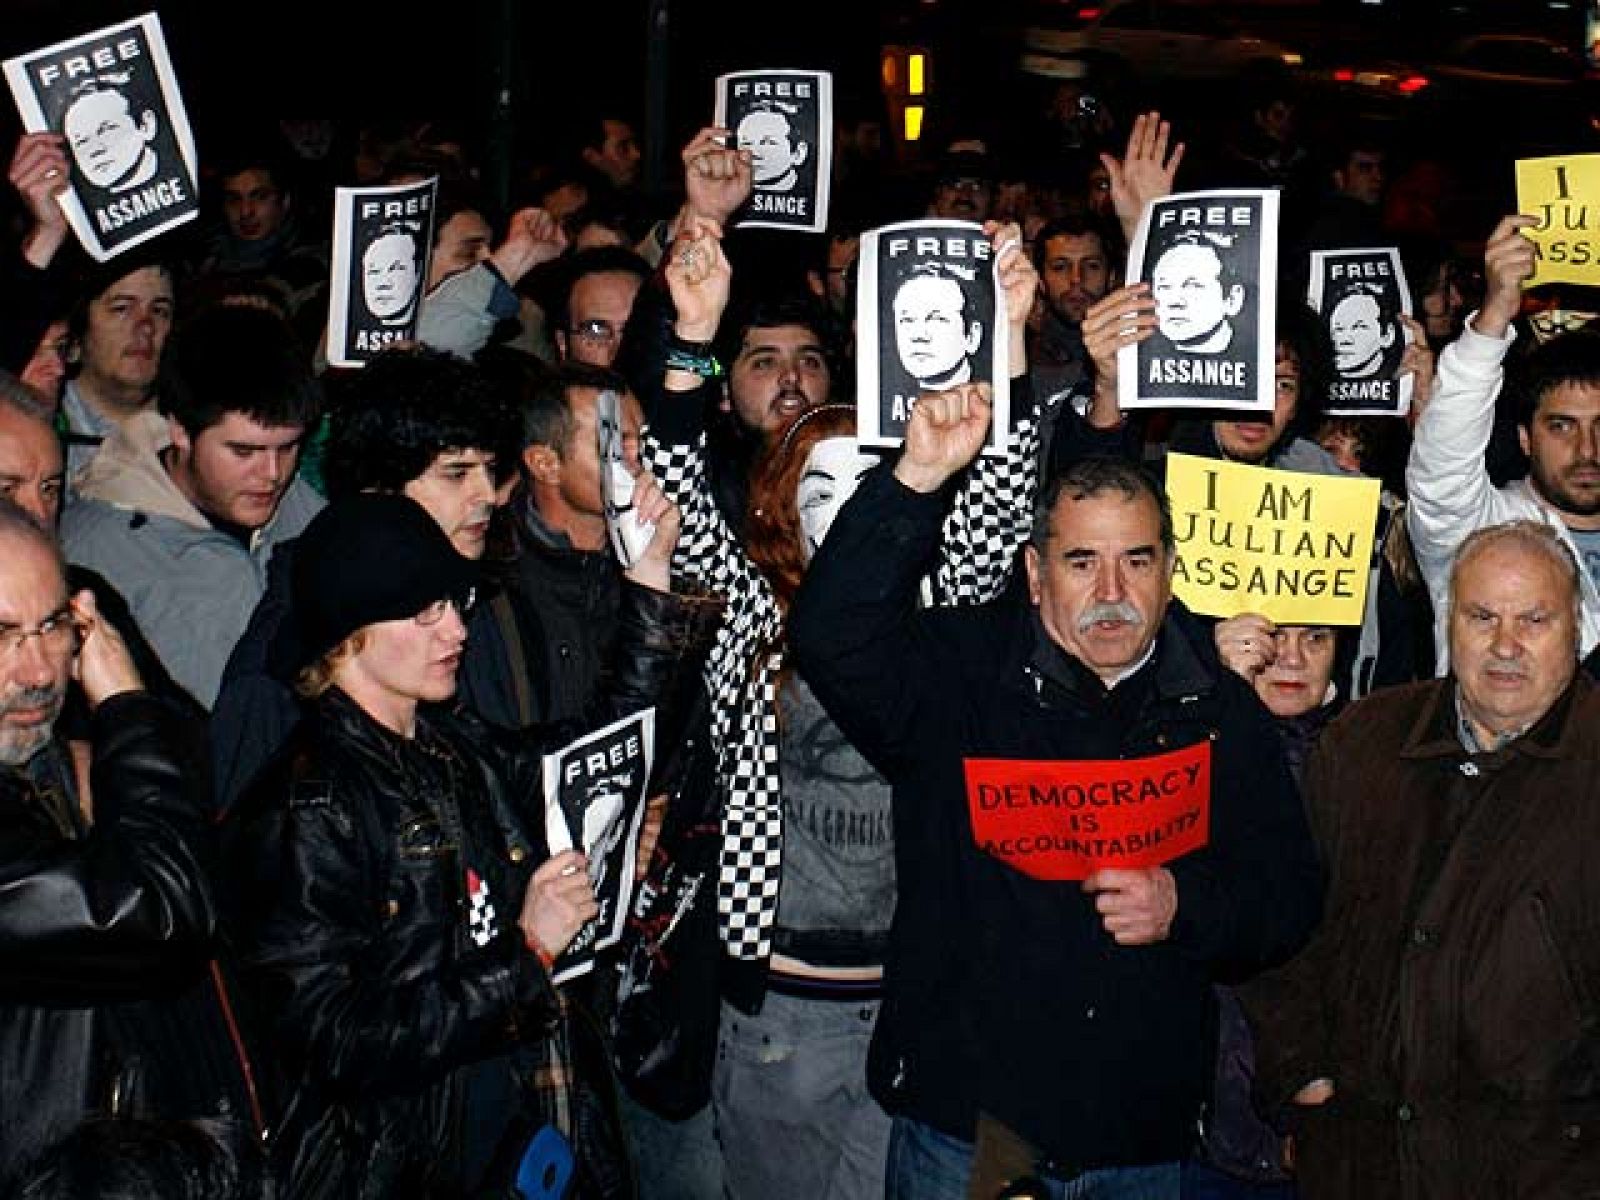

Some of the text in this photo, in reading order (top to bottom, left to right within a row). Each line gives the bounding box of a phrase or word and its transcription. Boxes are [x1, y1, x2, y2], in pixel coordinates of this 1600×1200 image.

[38, 39, 142, 86] FREE
[734, 81, 812, 99] FREE
[1554, 164, 1573, 200] I
[95, 177, 187, 234] ASSANGE
[1158, 206, 1252, 229] FREE
[889, 236, 991, 261] FREE
[1330, 261, 1391, 281] FREE
[1148, 357, 1247, 388] ASSANGE
[1203, 469, 1313, 523] I AM
[1173, 511, 1356, 560] JULIAN
[1172, 554, 1356, 599] ASSANGE
[564, 734, 639, 785] FREE
[977, 761, 1201, 811] DEMOCRACY
[982, 806, 1201, 858] ACCOUNTABILITY
[1069, 813, 1099, 833] IS
